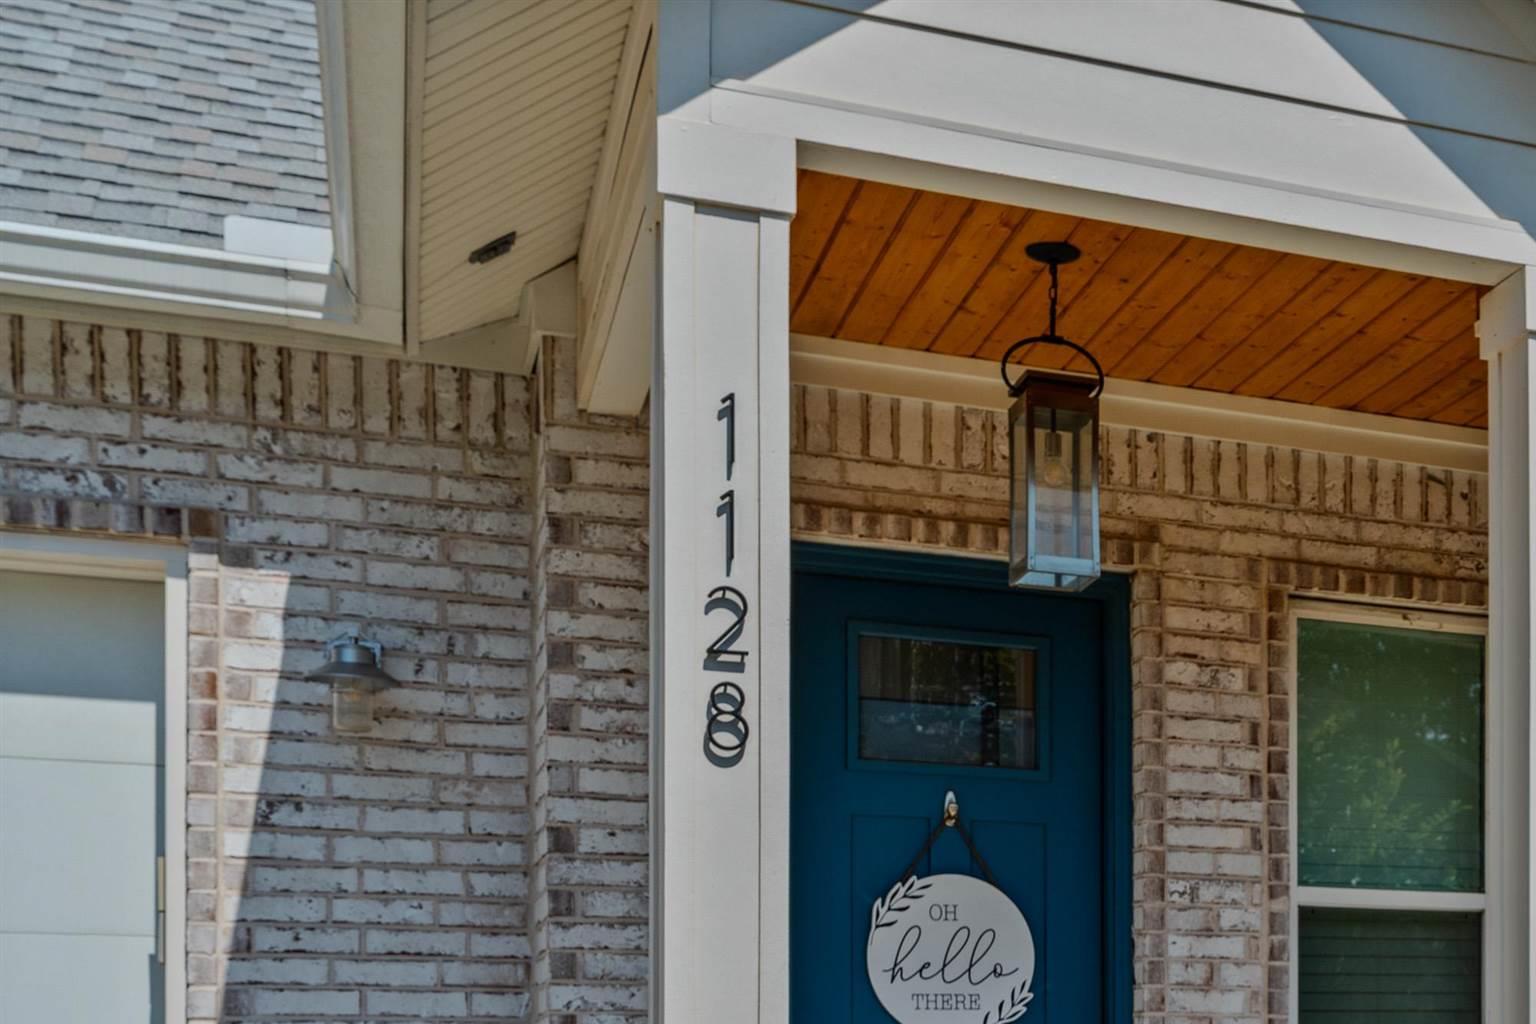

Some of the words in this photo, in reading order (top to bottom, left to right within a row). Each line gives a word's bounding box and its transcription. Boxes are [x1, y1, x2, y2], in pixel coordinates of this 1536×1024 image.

[705, 393, 749, 759] 1128
[928, 903, 959, 922] OH
[882, 925, 1019, 986] hello
[911, 993, 981, 1011] THERE
